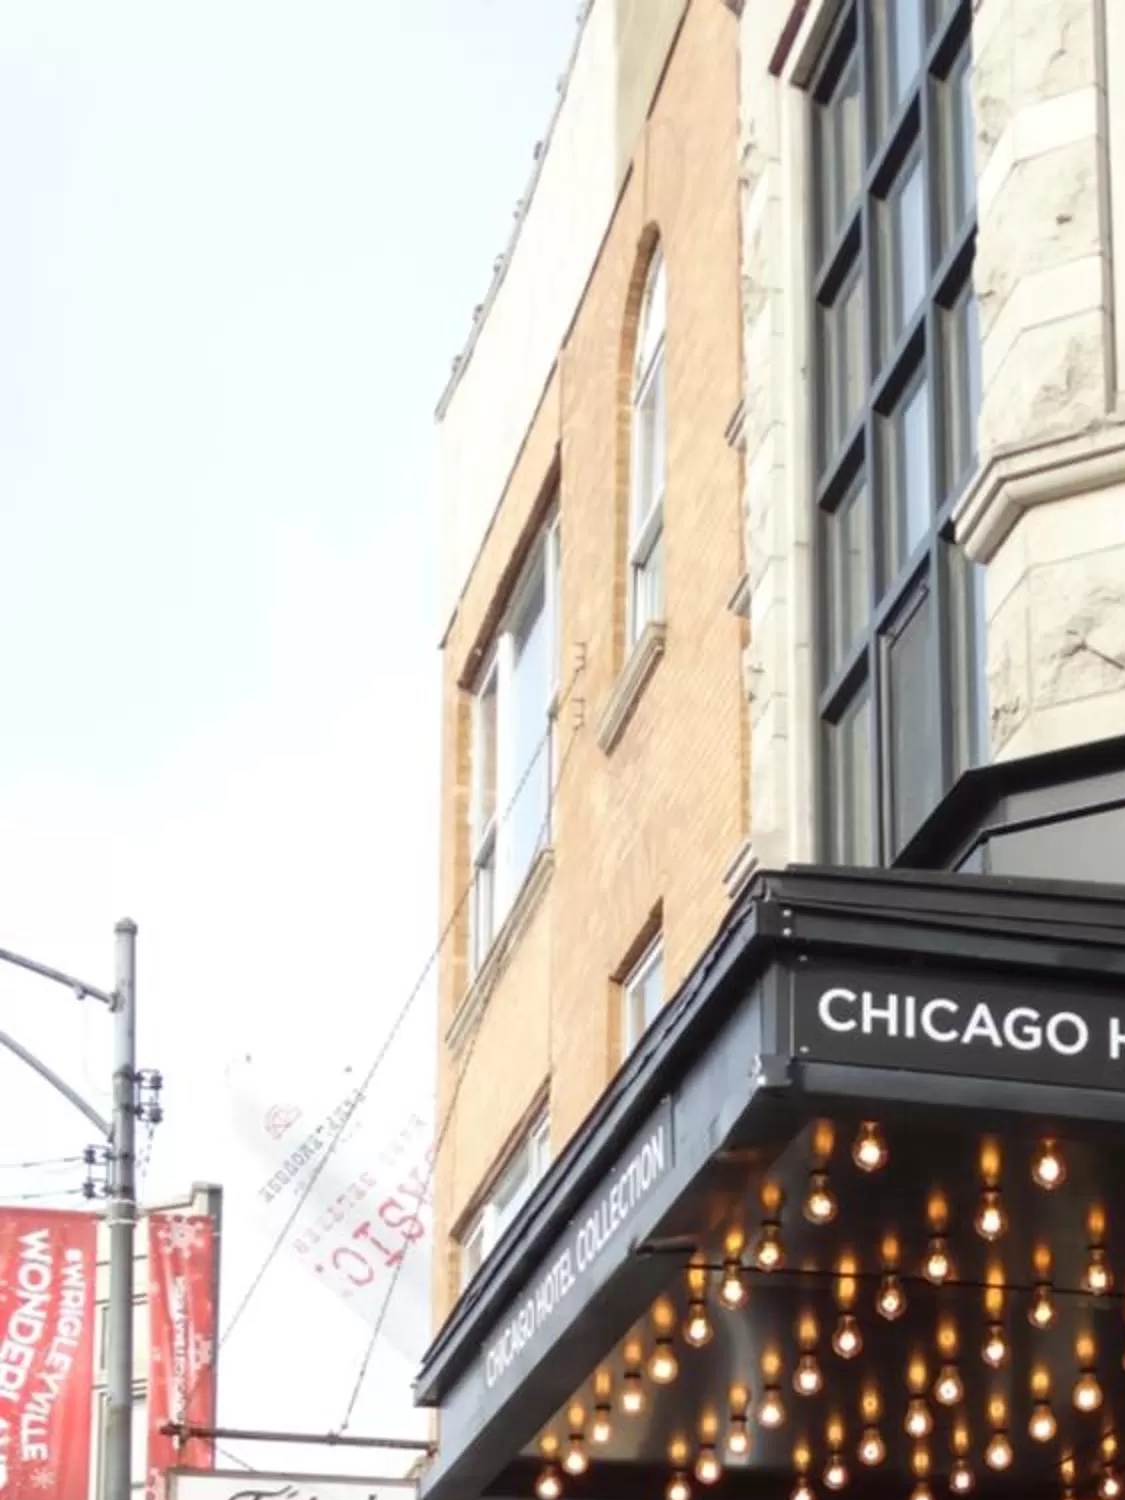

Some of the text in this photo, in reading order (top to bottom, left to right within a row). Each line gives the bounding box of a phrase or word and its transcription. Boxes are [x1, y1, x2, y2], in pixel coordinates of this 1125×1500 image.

[818, 986, 1089, 1056] CHICAGO
[484, 1125, 665, 1388] CHICAGO HOTEL COLLECTION
